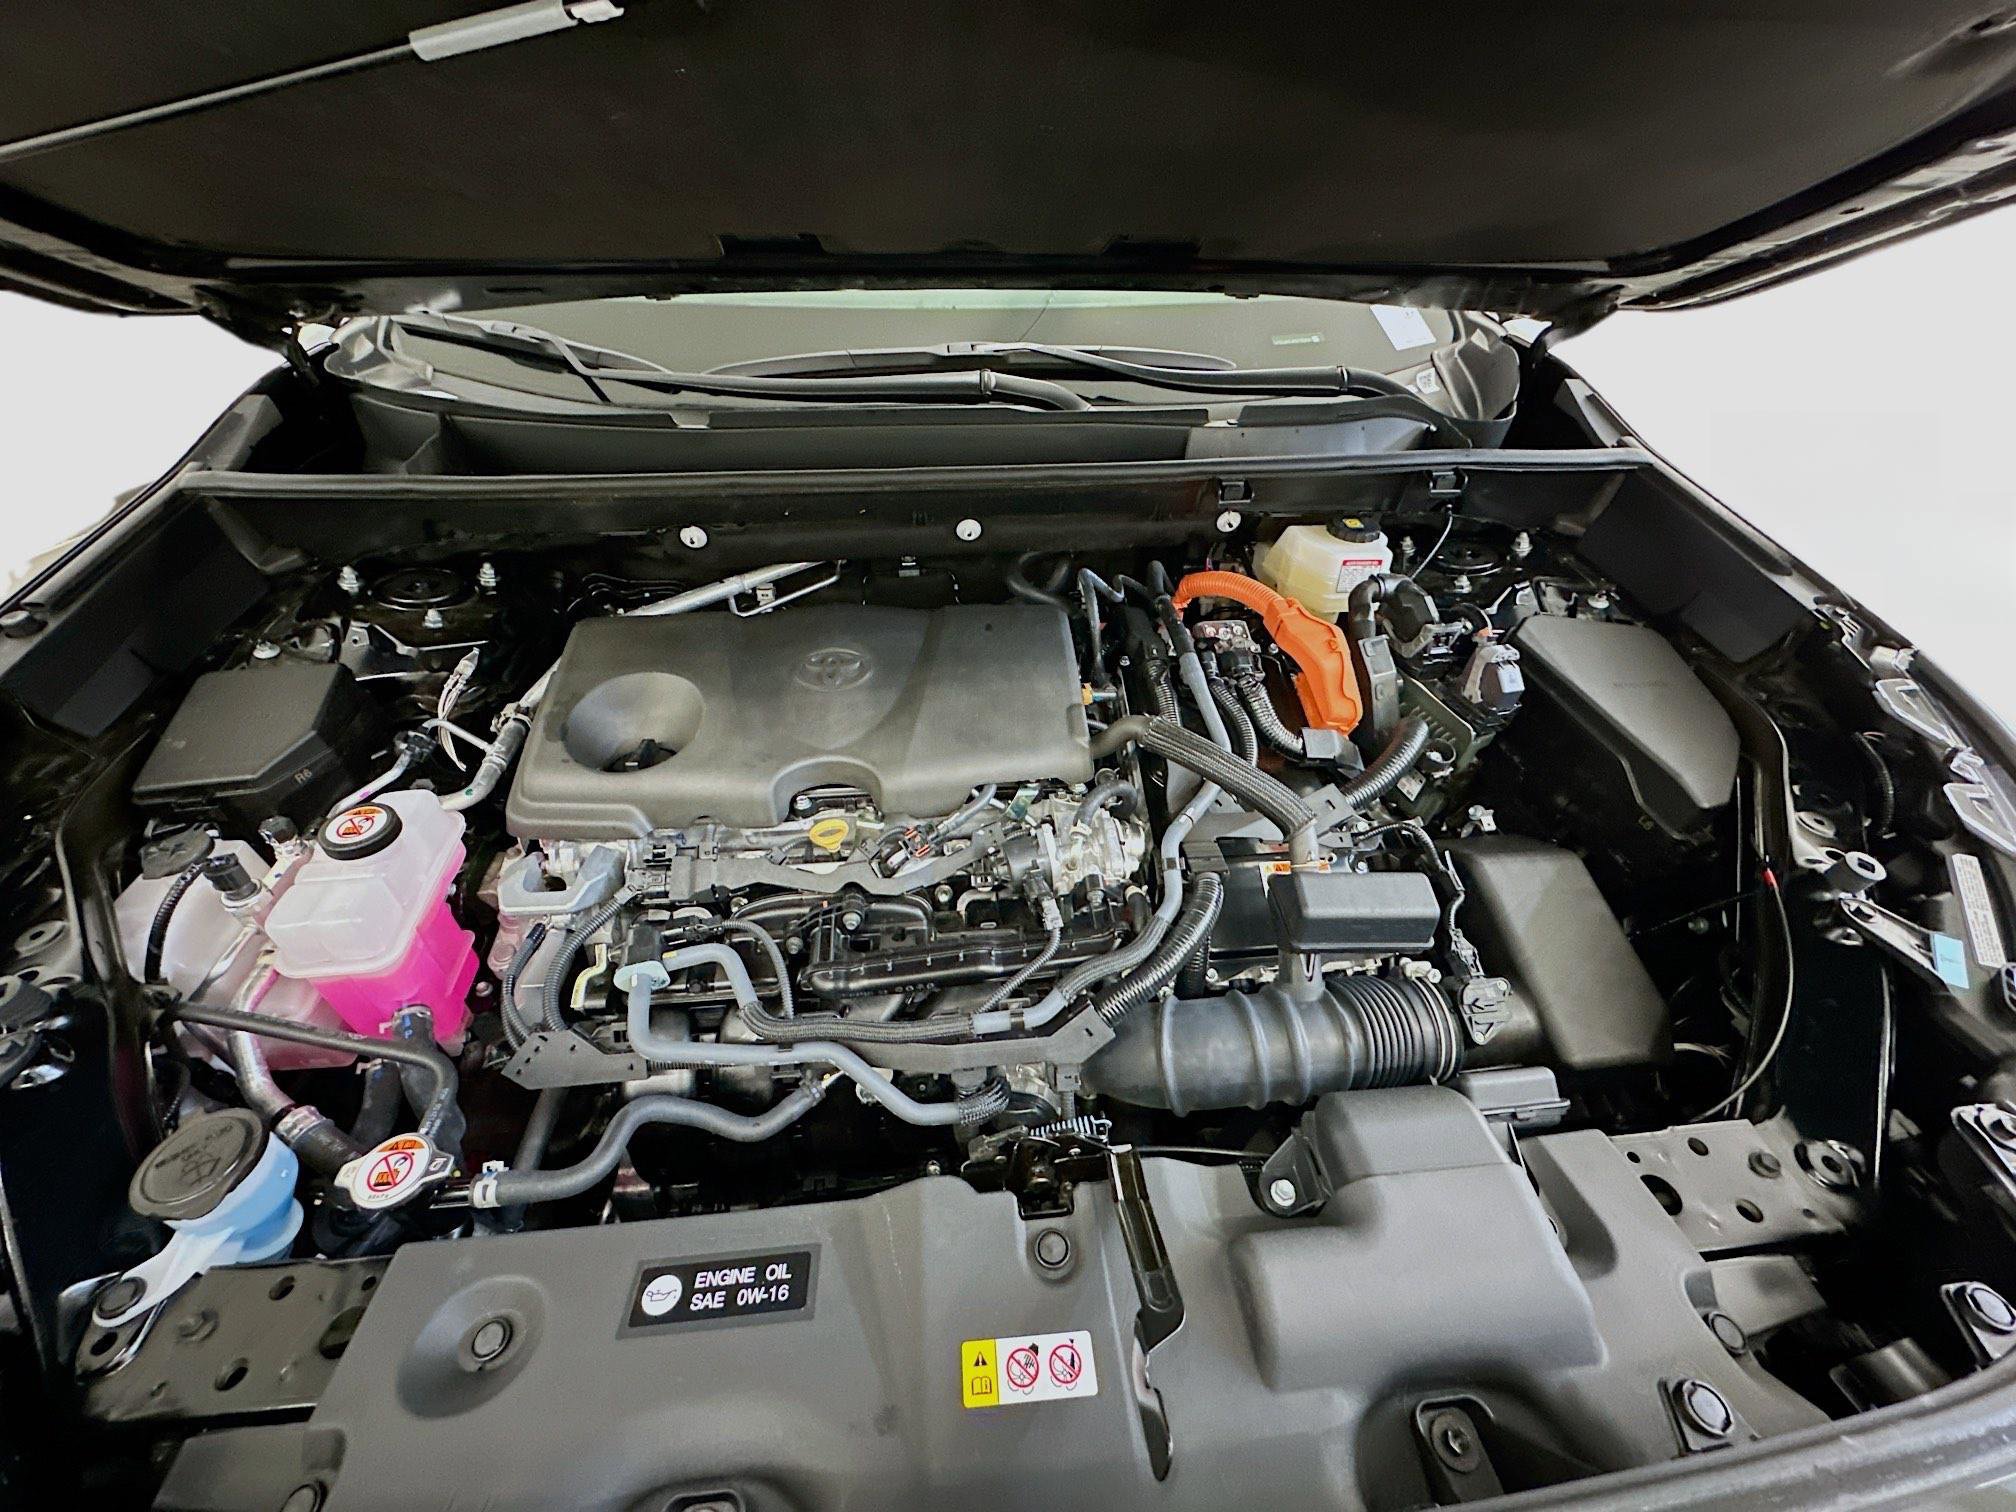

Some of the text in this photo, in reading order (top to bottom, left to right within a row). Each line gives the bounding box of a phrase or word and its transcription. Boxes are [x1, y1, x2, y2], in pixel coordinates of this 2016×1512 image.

[694, 1263, 792, 1288] ENGINE OIL
[689, 1284, 790, 1311] SAE 0W-16
